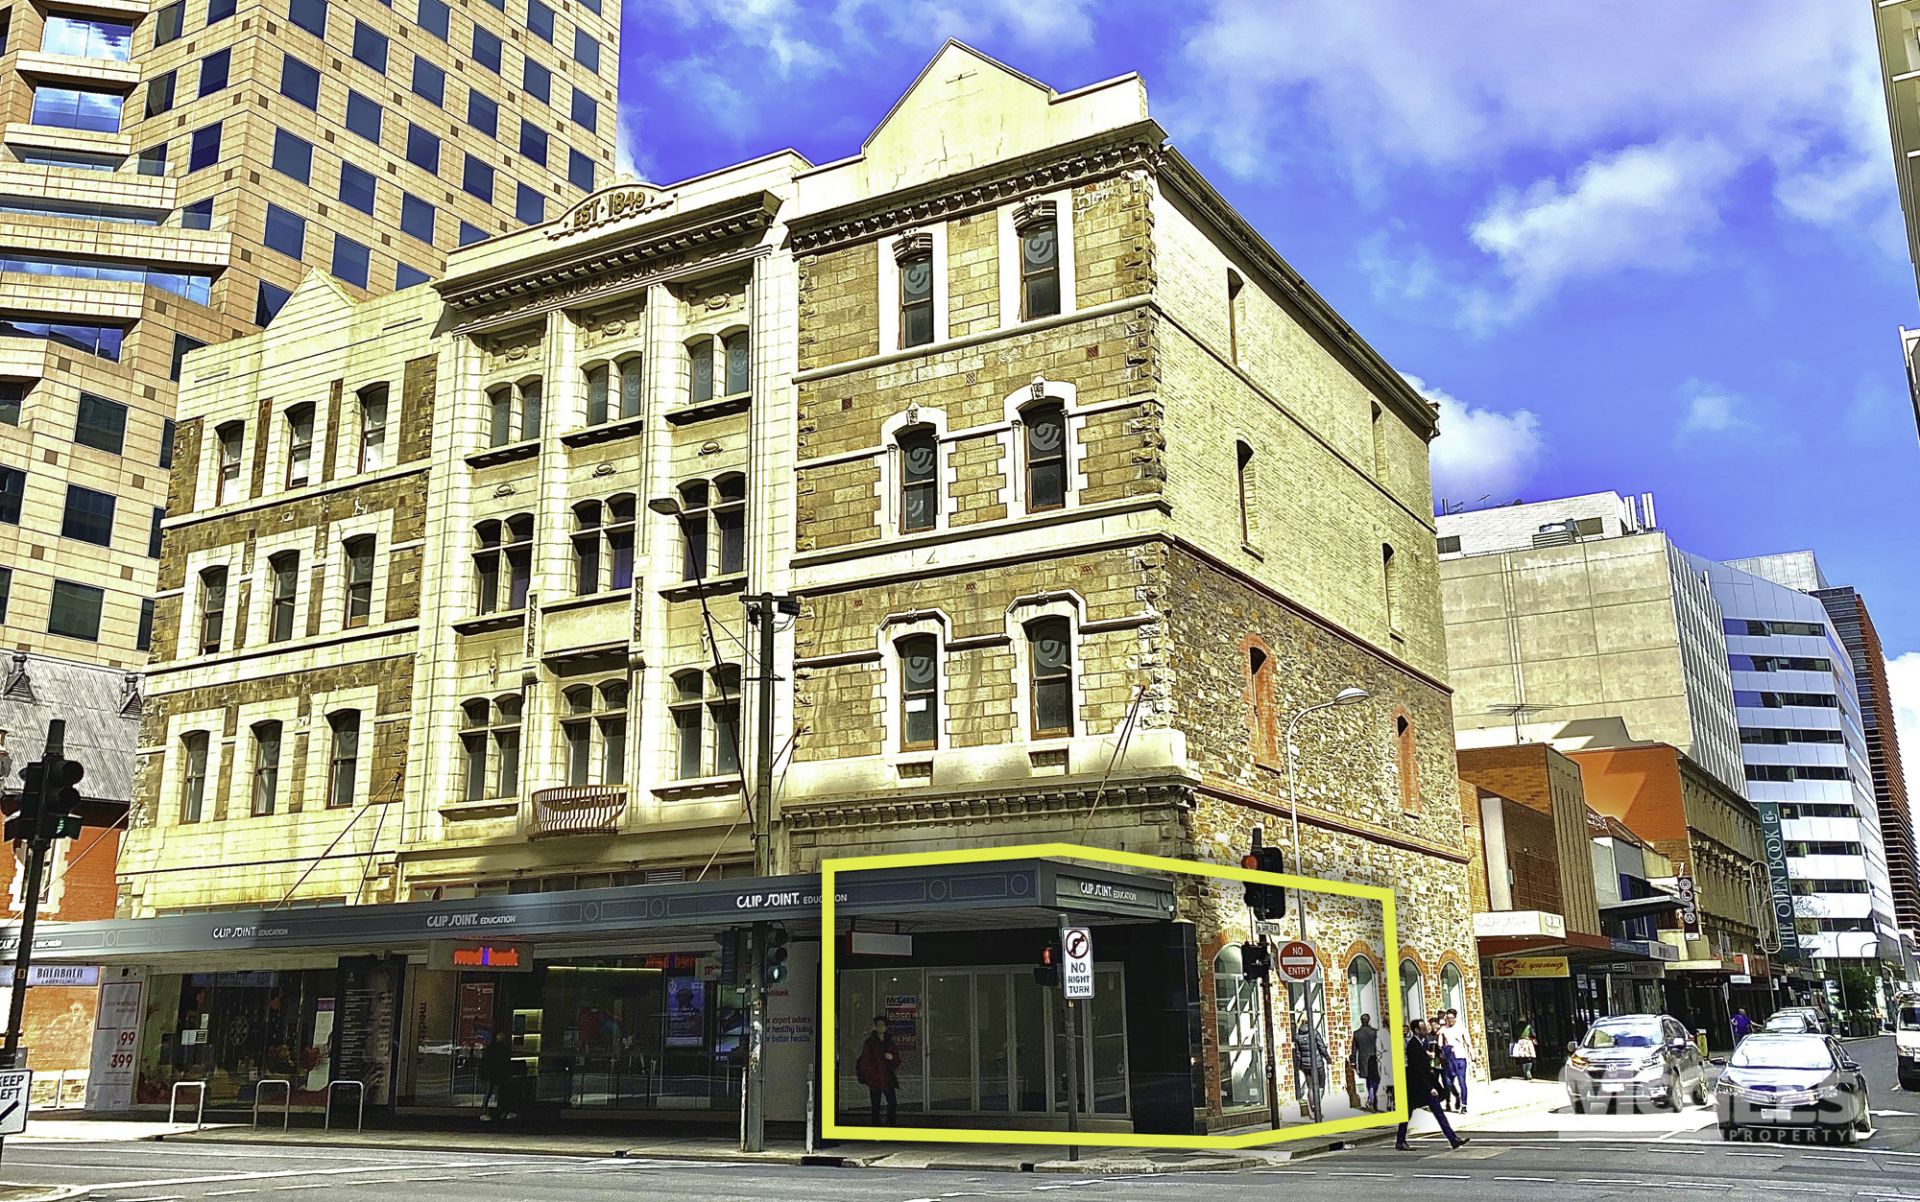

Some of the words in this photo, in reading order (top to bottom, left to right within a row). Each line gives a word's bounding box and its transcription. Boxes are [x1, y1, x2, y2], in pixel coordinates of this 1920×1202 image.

[608, 191, 645, 217] 1849
[1765, 829, 1785, 870] BOOK
[1080, 882, 1094, 894] CLIP
[1113, 890, 1137, 901] EDUCATION
[1773, 876, 1792, 917] OPEN
[736, 894, 763, 908] CLIP
[803, 893, 848, 905] EDUCON
[426, 915, 449, 928] CLIP
[480, 915, 516, 925] EDUCATION
[213, 927, 232, 939] CLIP
[1779, 922, 1797, 950] THE
[1292, 946, 1304, 956] NO
[1070, 962, 1086, 973] NO
[1287, 966, 1311, 976] ENTRY
[1067, 975, 1090, 984] RIGHT
[1068, 985, 1090, 994] TURN
[0, 1087, 22, 1100] EFT
